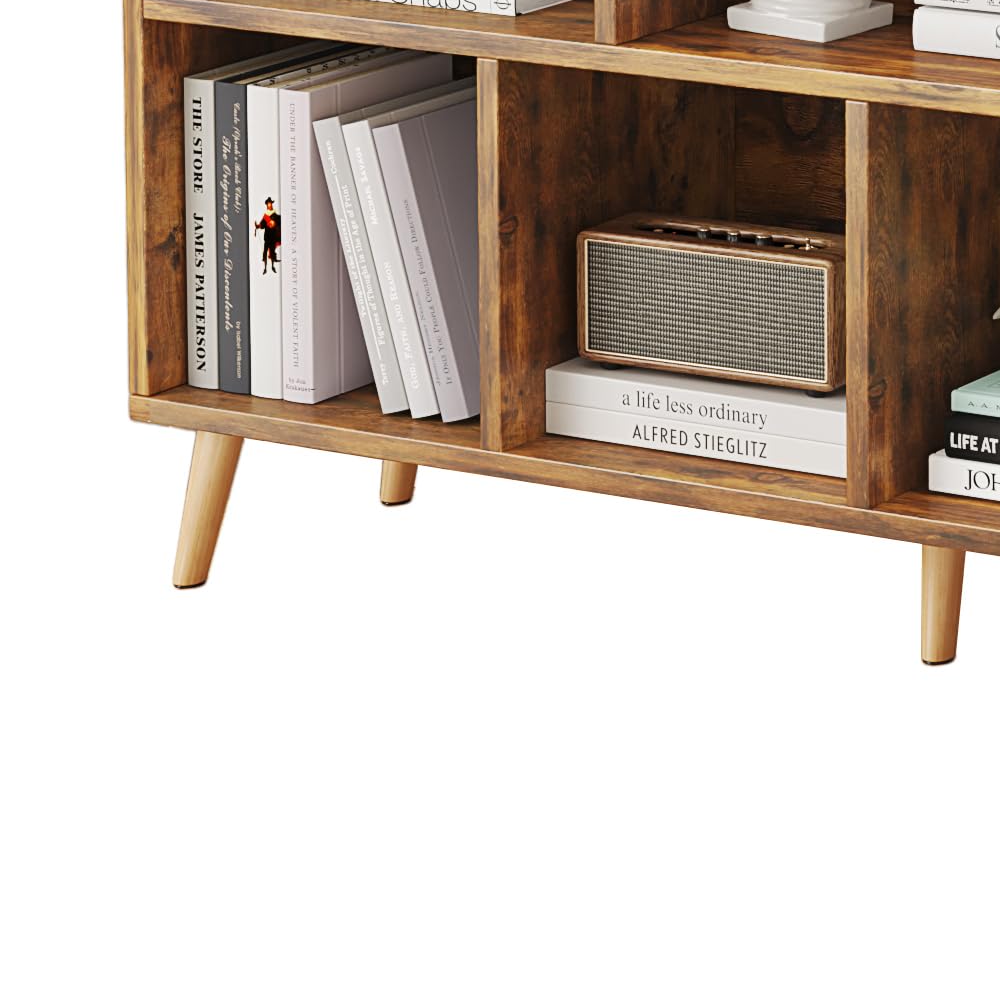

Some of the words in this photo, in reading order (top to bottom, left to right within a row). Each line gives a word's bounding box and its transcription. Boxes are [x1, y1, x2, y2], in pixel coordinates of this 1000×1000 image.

[192, 97, 203, 132] THE
[192, 137, 203, 194] STORE
[221, 136, 232, 160] The
[219, 164, 231, 211] Origins
[220, 214, 233, 229] of
[193, 213, 205, 268] JAMES
[222, 231, 233, 255] Our
[222, 258, 234, 331] Discontents
[291, 287, 299, 299] OF
[194, 274, 207, 372] PATTERSON
[622, 394, 630, 406] a
[636, 390, 660, 410] life
[666, 395, 693, 416] less
[698, 402, 768, 430] ordinary
[632, 424, 688, 447] ALFRED
[694, 432, 767, 459] STIEGLITZ
[950, 432, 979, 452] LIFE
[981, 437, 999, 453] AT
